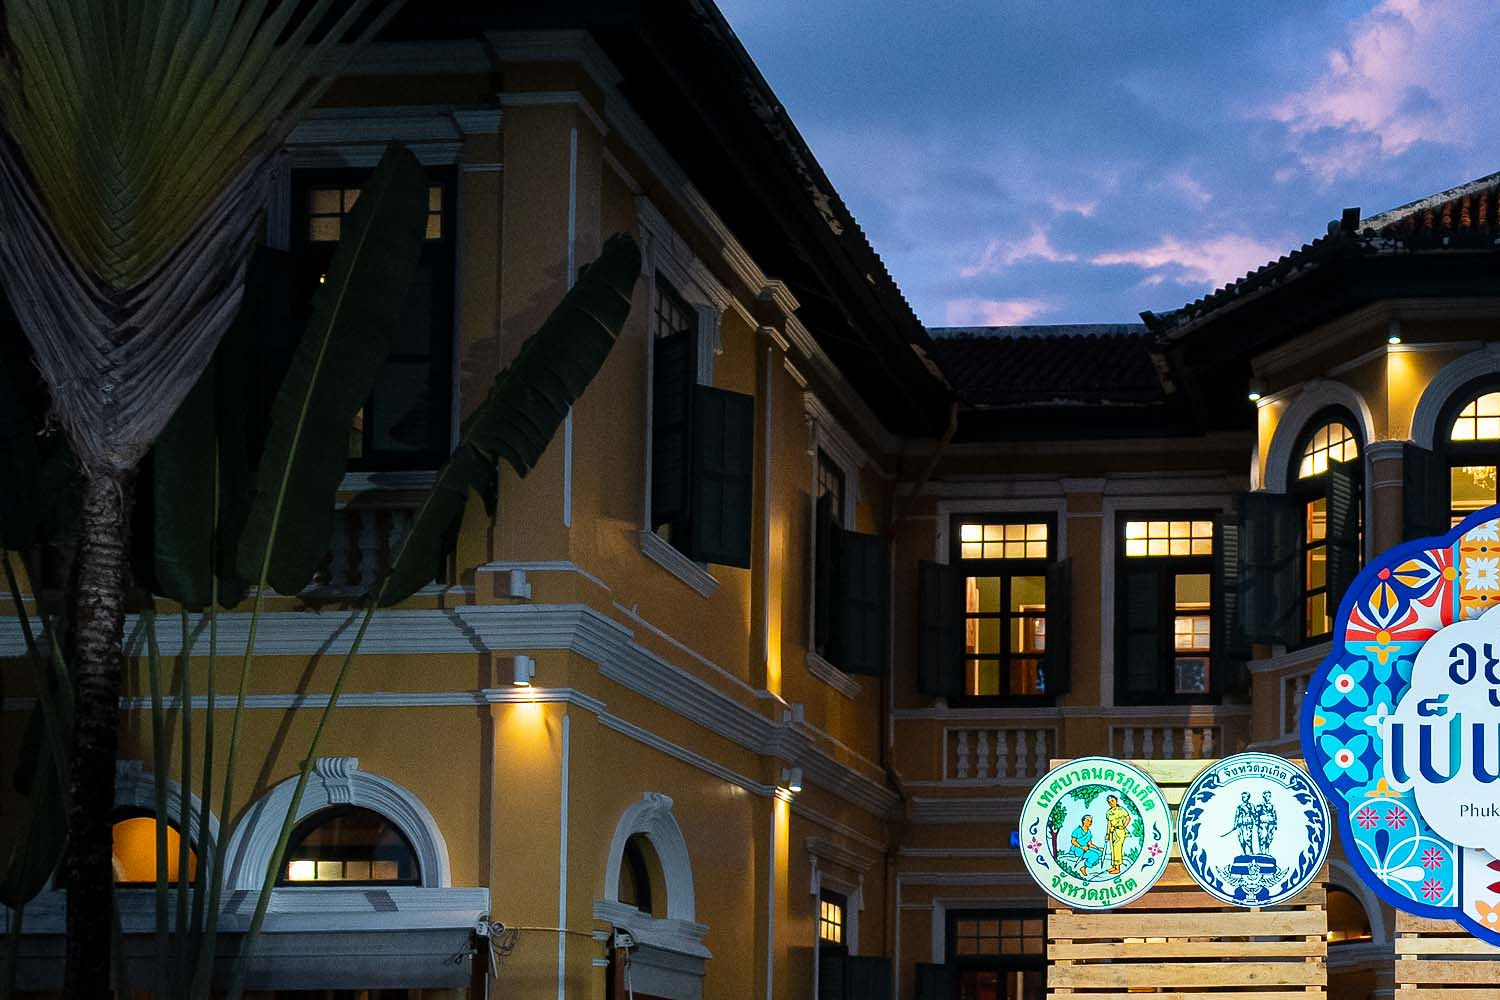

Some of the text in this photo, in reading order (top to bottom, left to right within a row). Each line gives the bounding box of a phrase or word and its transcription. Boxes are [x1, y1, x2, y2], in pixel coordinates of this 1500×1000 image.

[1223, 761, 1287, 780] จังหวัดภูเก็ต
[1036, 767, 1156, 811] เทศบาลนครภูเก็ต
[1051, 871, 1138, 906] จังหวัดภูเก็ต
